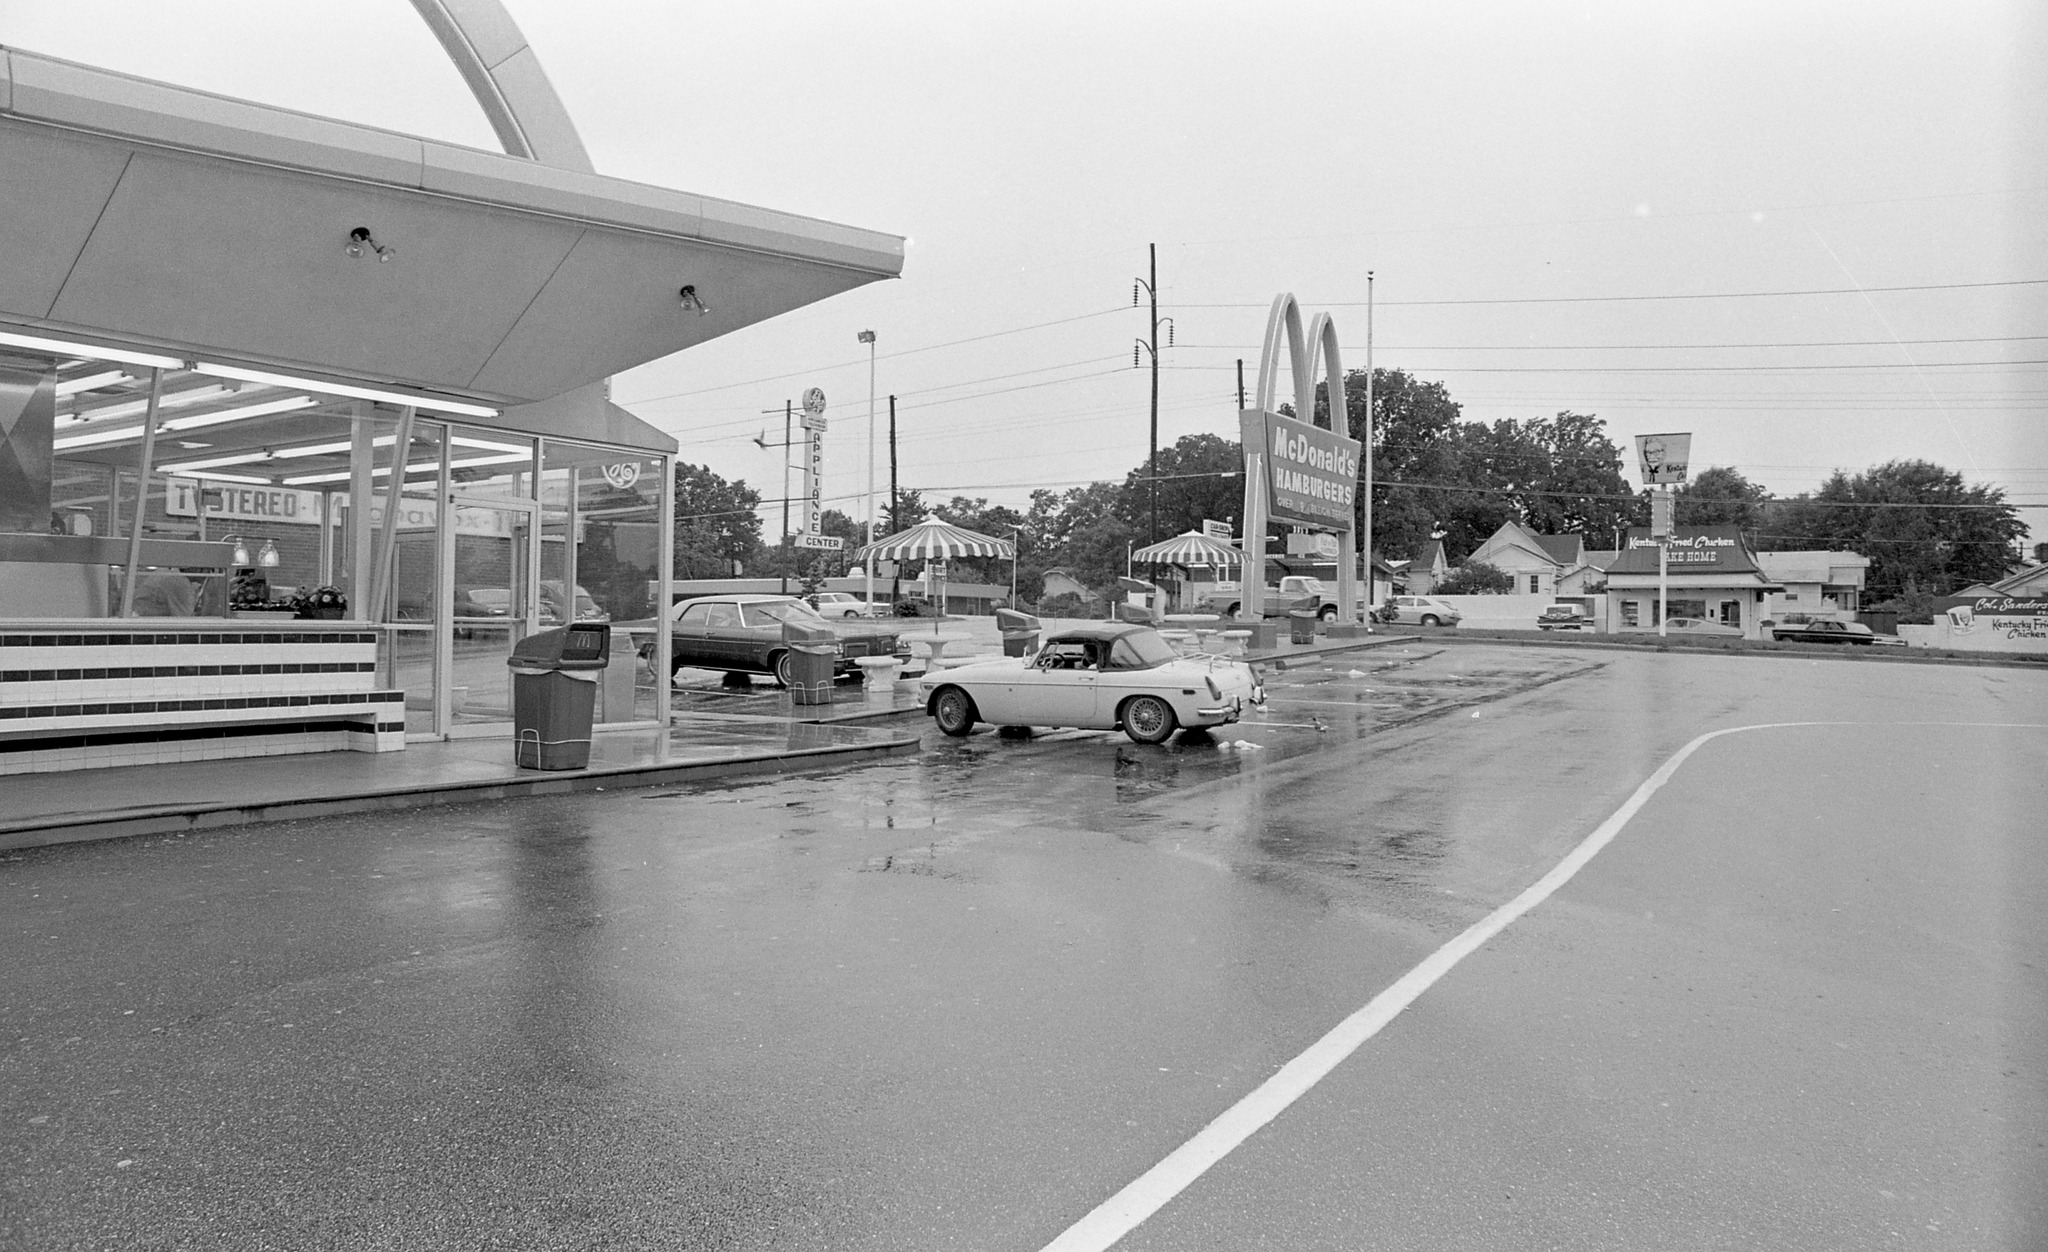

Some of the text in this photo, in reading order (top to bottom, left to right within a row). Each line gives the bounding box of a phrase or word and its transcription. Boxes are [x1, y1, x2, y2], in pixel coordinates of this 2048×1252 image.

[1275, 426, 1355, 478] McDonald's
[811, 432, 821, 533] APPLIANCE
[1276, 467, 1352, 505] HAMBURGERS
[1277, 496, 1293, 508] OVER
[806, 537, 839, 548] CENTER
[1694, 536, 1734, 549] Chicken
[1666, 551, 1716, 562] AKE HOME
[1975, 598, 2048, 612] Col. Sanders
[1993, 618, 2048, 631] Kentucky Fri
[2007, 629, 2046, 640] Chicken
